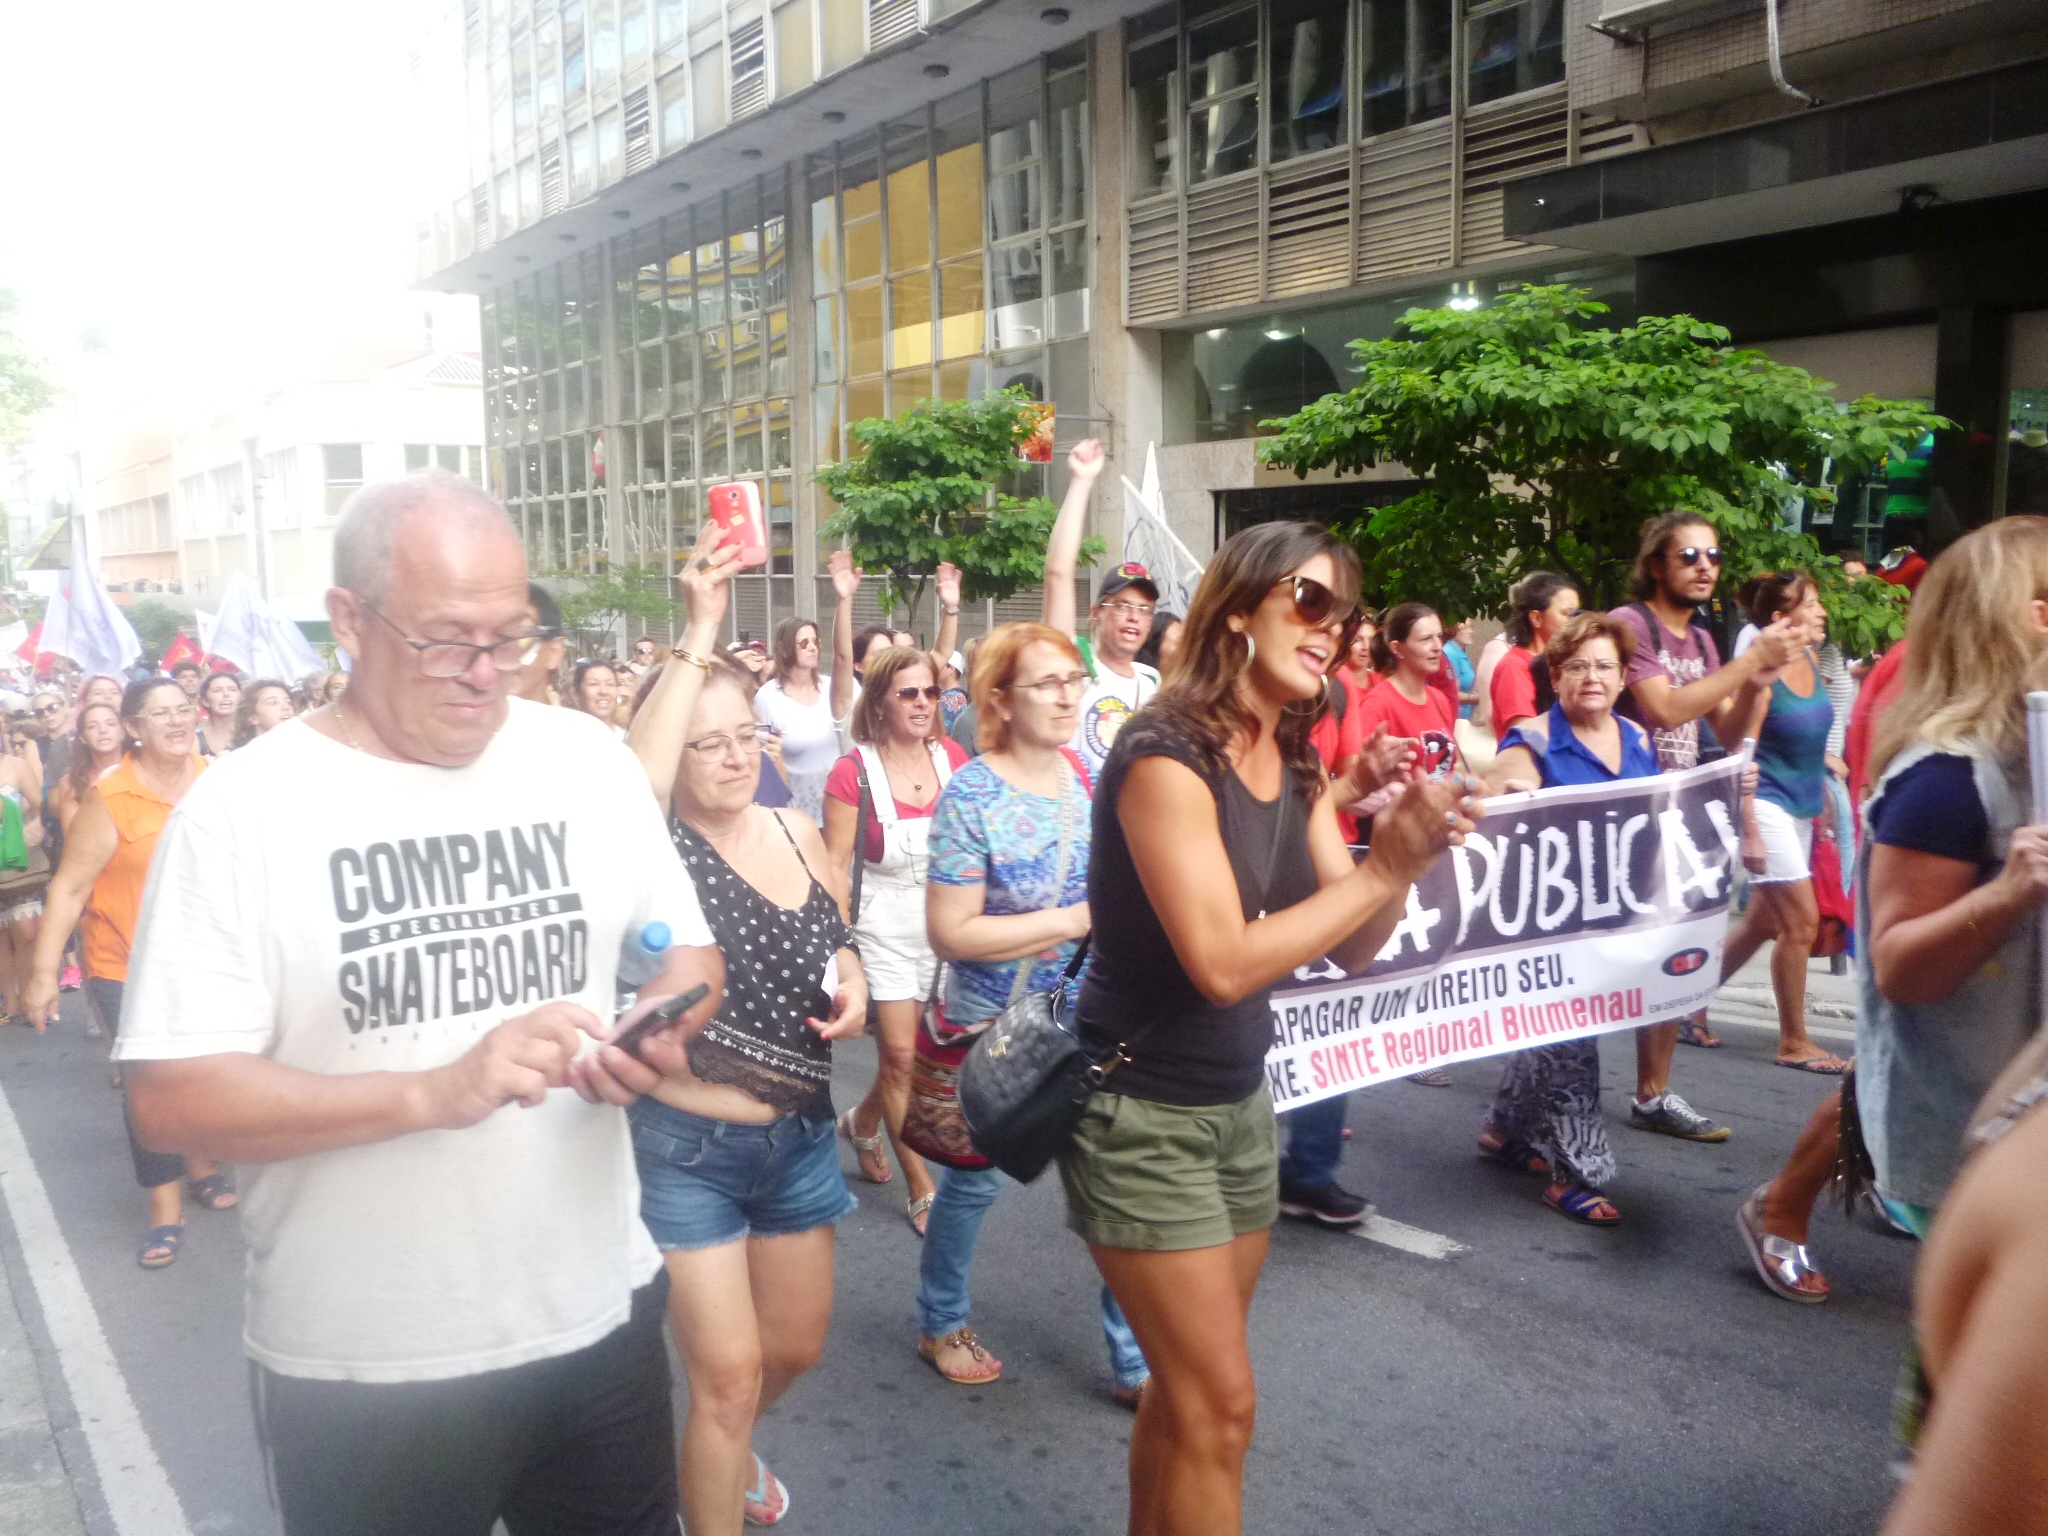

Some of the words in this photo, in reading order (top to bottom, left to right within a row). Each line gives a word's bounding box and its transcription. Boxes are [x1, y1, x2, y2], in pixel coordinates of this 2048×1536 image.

[328, 820, 570, 924] COMPANY
[367, 898, 560, 944] SPECIALIZED
[338, 918, 589, 1034] SKATEBOARD
[1371, 985, 1412, 1024] UM
[1416, 962, 1507, 1014] DIREITO
[1518, 952, 1574, 993] SEU.
[1311, 1036, 1380, 1089] SINTE
[1382, 1009, 1493, 1069] Regional
[1501, 987, 1643, 1042] Blumenau
